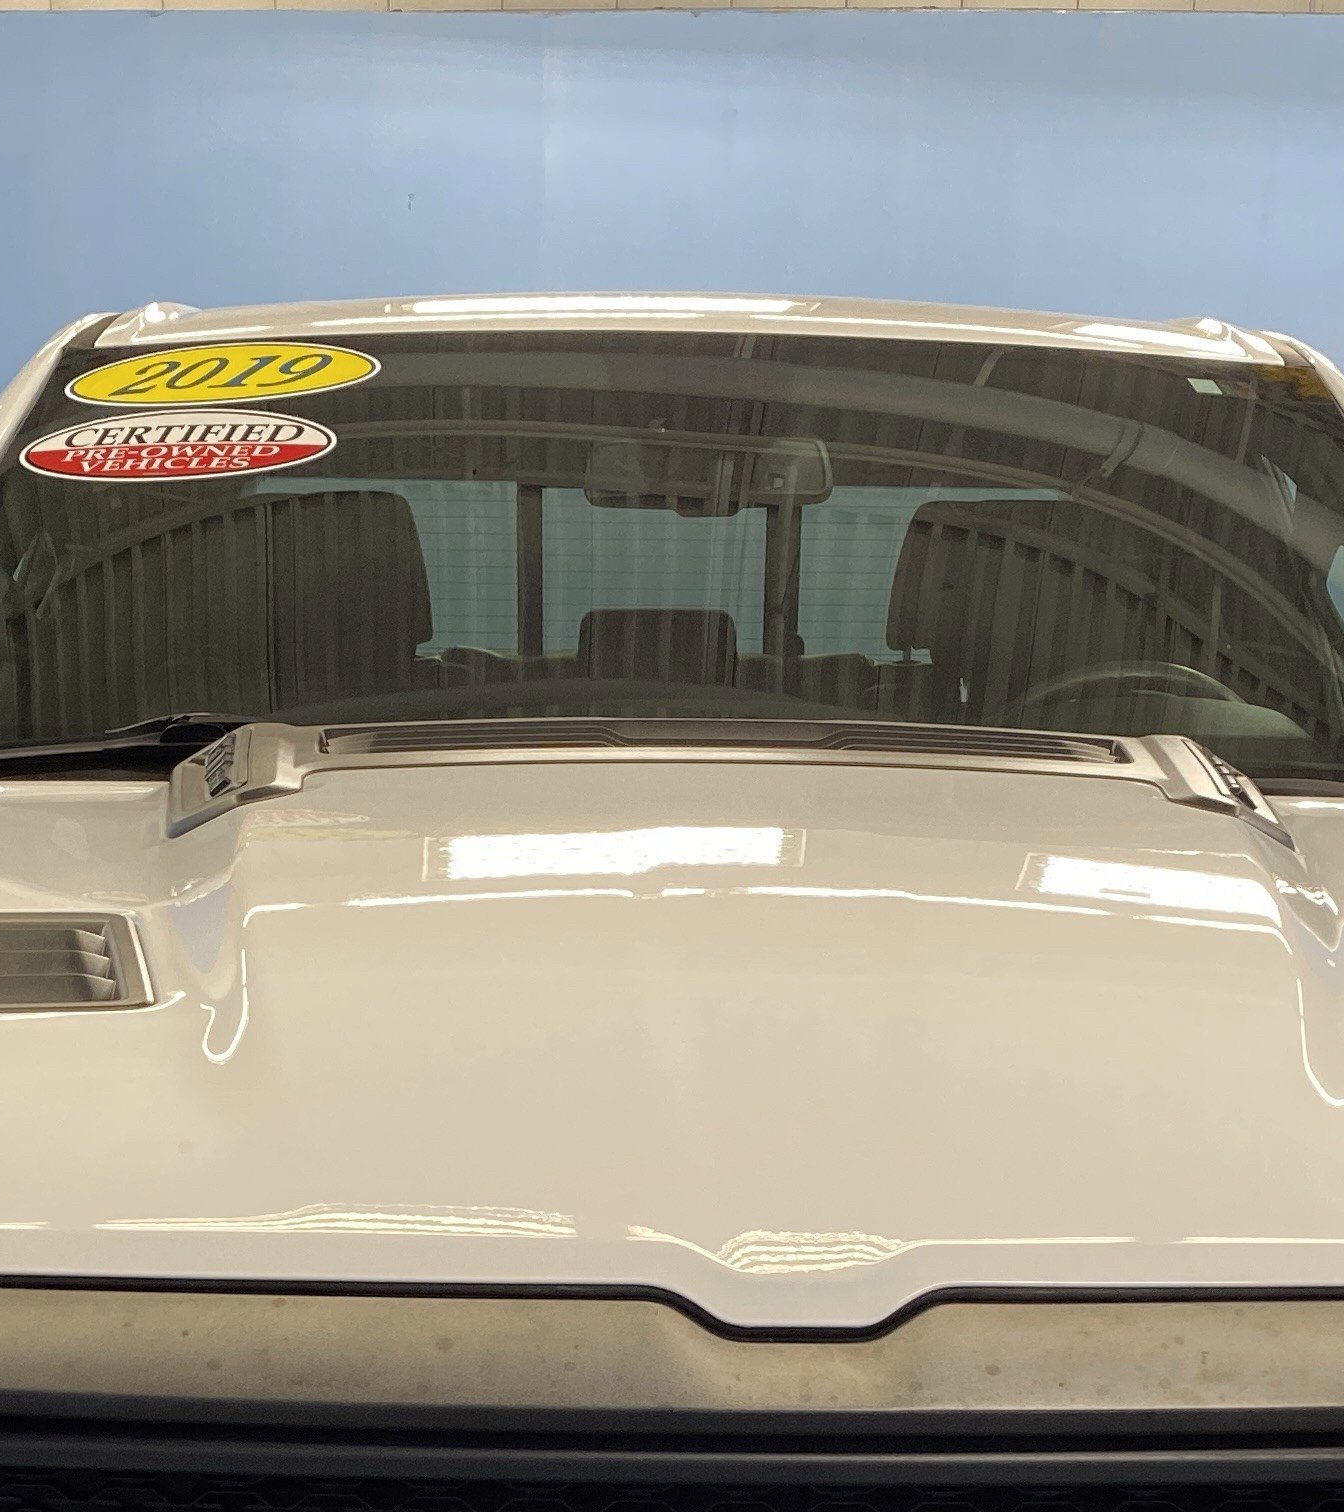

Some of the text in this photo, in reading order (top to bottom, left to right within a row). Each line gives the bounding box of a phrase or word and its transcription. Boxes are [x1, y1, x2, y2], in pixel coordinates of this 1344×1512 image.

[108, 353, 333, 397] 2019
[64, 424, 305, 448] CERTIFIED
[61, 445, 280, 463] PRE-OWNED
[80, 456, 251, 473] VEHICLES
